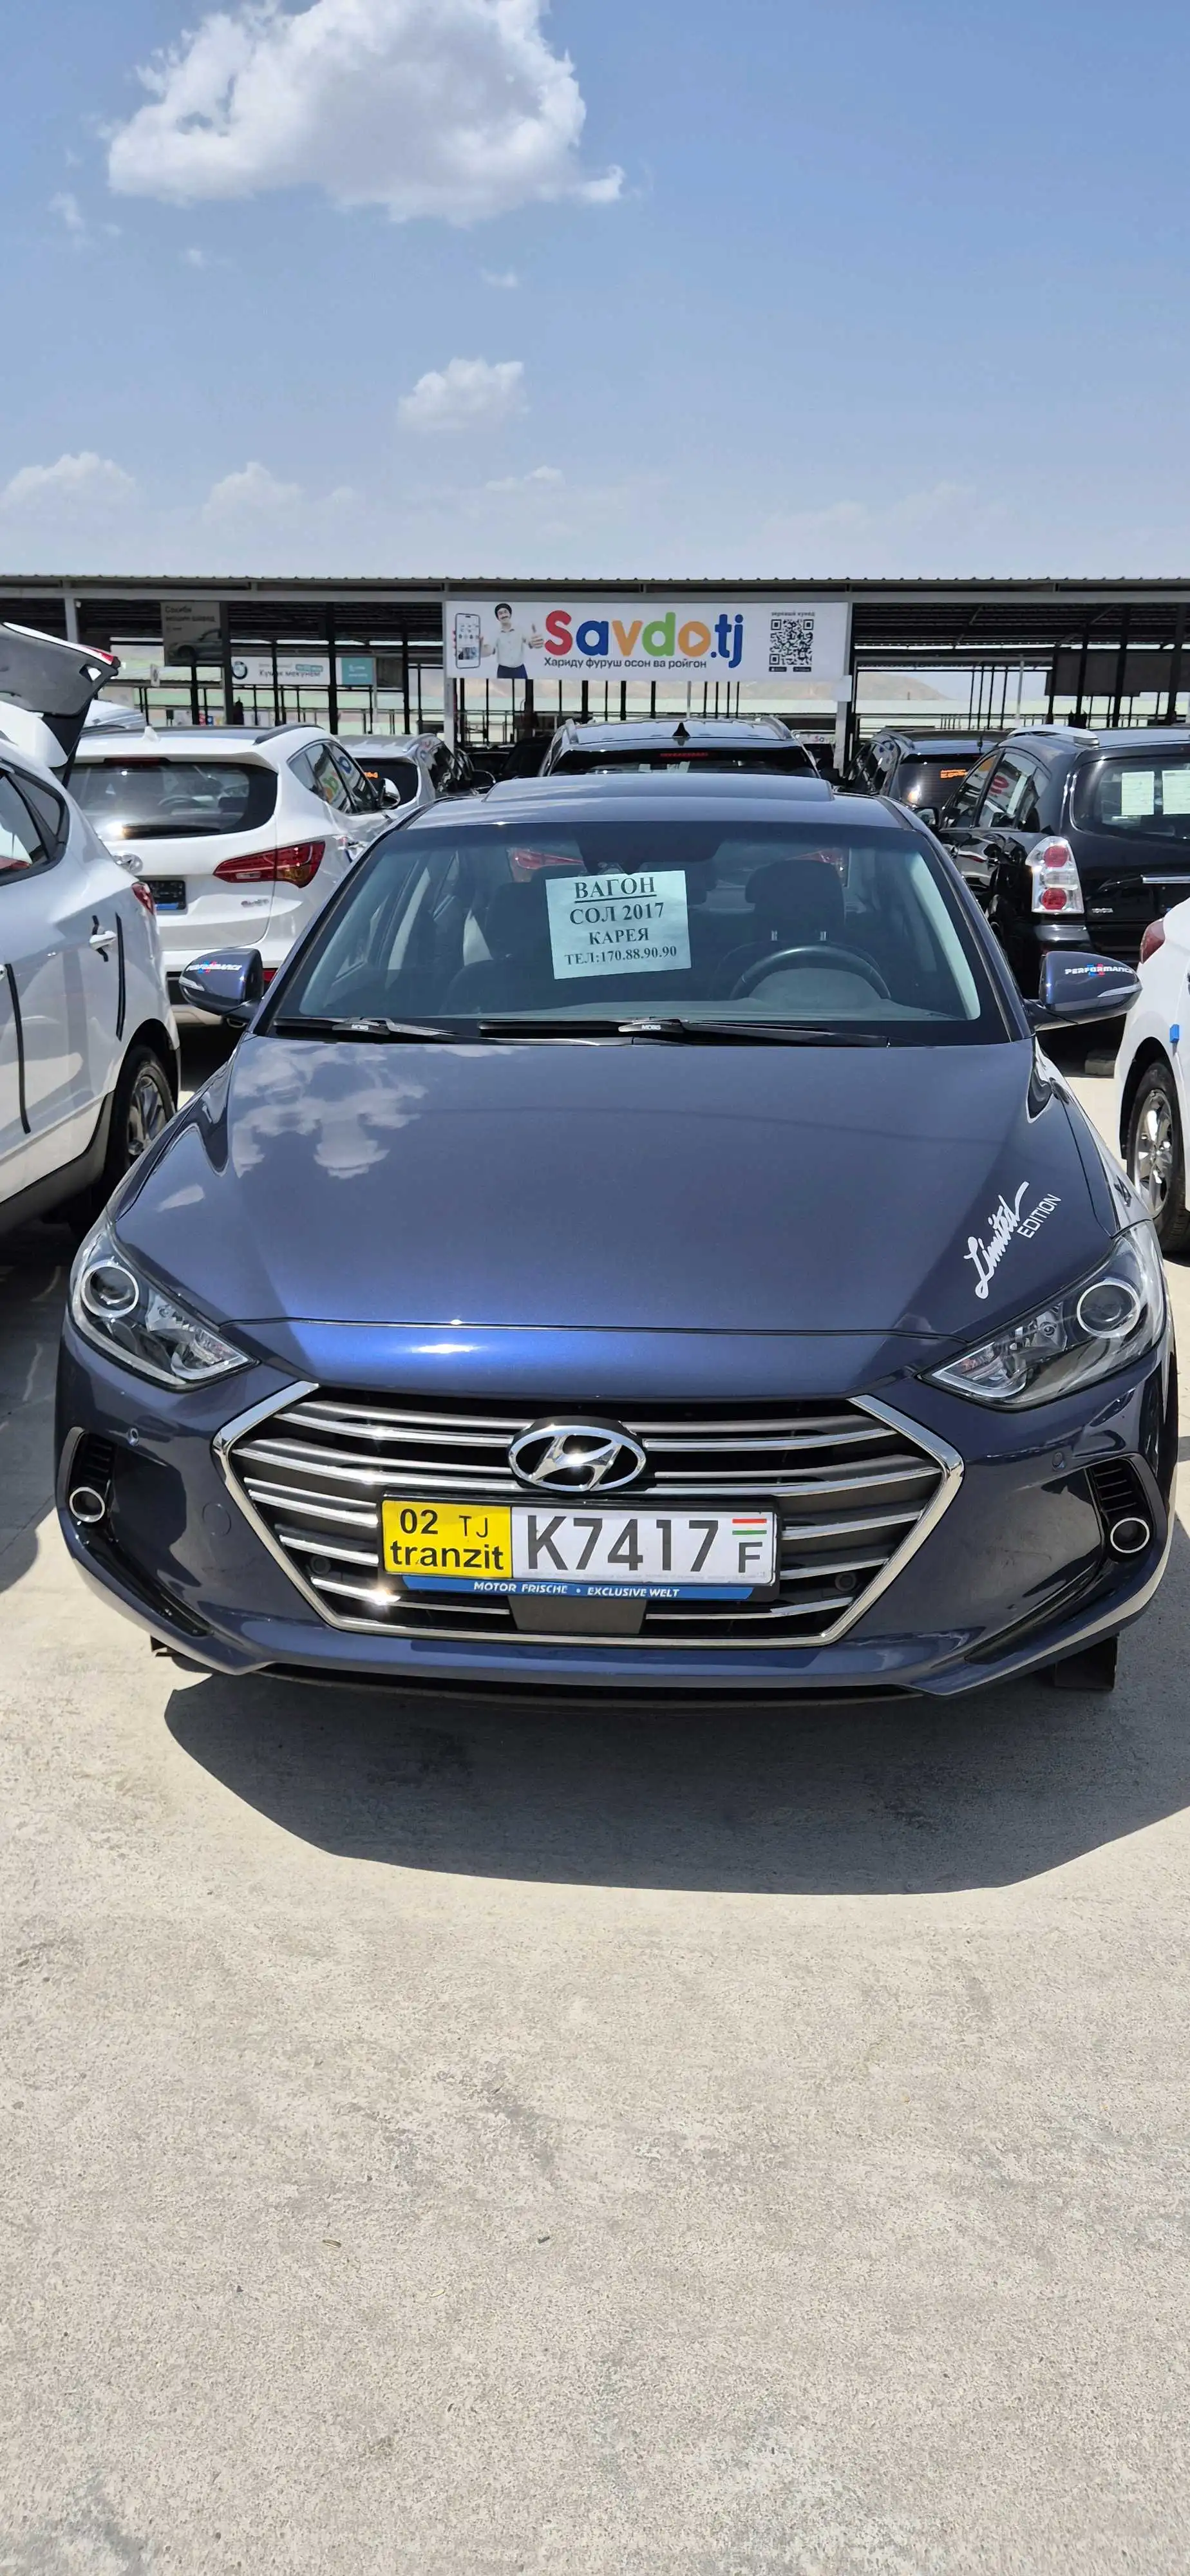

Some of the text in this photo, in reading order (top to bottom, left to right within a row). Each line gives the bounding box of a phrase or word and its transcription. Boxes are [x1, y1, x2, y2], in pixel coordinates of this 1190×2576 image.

[544, 610, 742, 668] Savdo.tj
[544, 658, 583, 668] Хариду
[585, 657, 621, 668] фуруш
[668, 658, 707, 669] ройгон
[574, 876, 654, 899] ВАГОН
[570, 902, 664, 925] СОЛ 2017
[589, 927, 649, 945] КАРЕЯ
[565, 945, 677, 965] ТЕЛ:170.88.90.90
[1017, 1193, 1062, 1238] EDITION
[963, 1181, 1030, 1300] Limited
[400, 1508, 489, 1538] 02 TJ
[390, 1540, 504, 1570] tranzit
[527, 1514, 719, 1573] K7417
[738, 1542, 763, 1573] F
[474, 1582, 680, 1598] MOTOR FRISCHE EXCLUSIVE WELT
